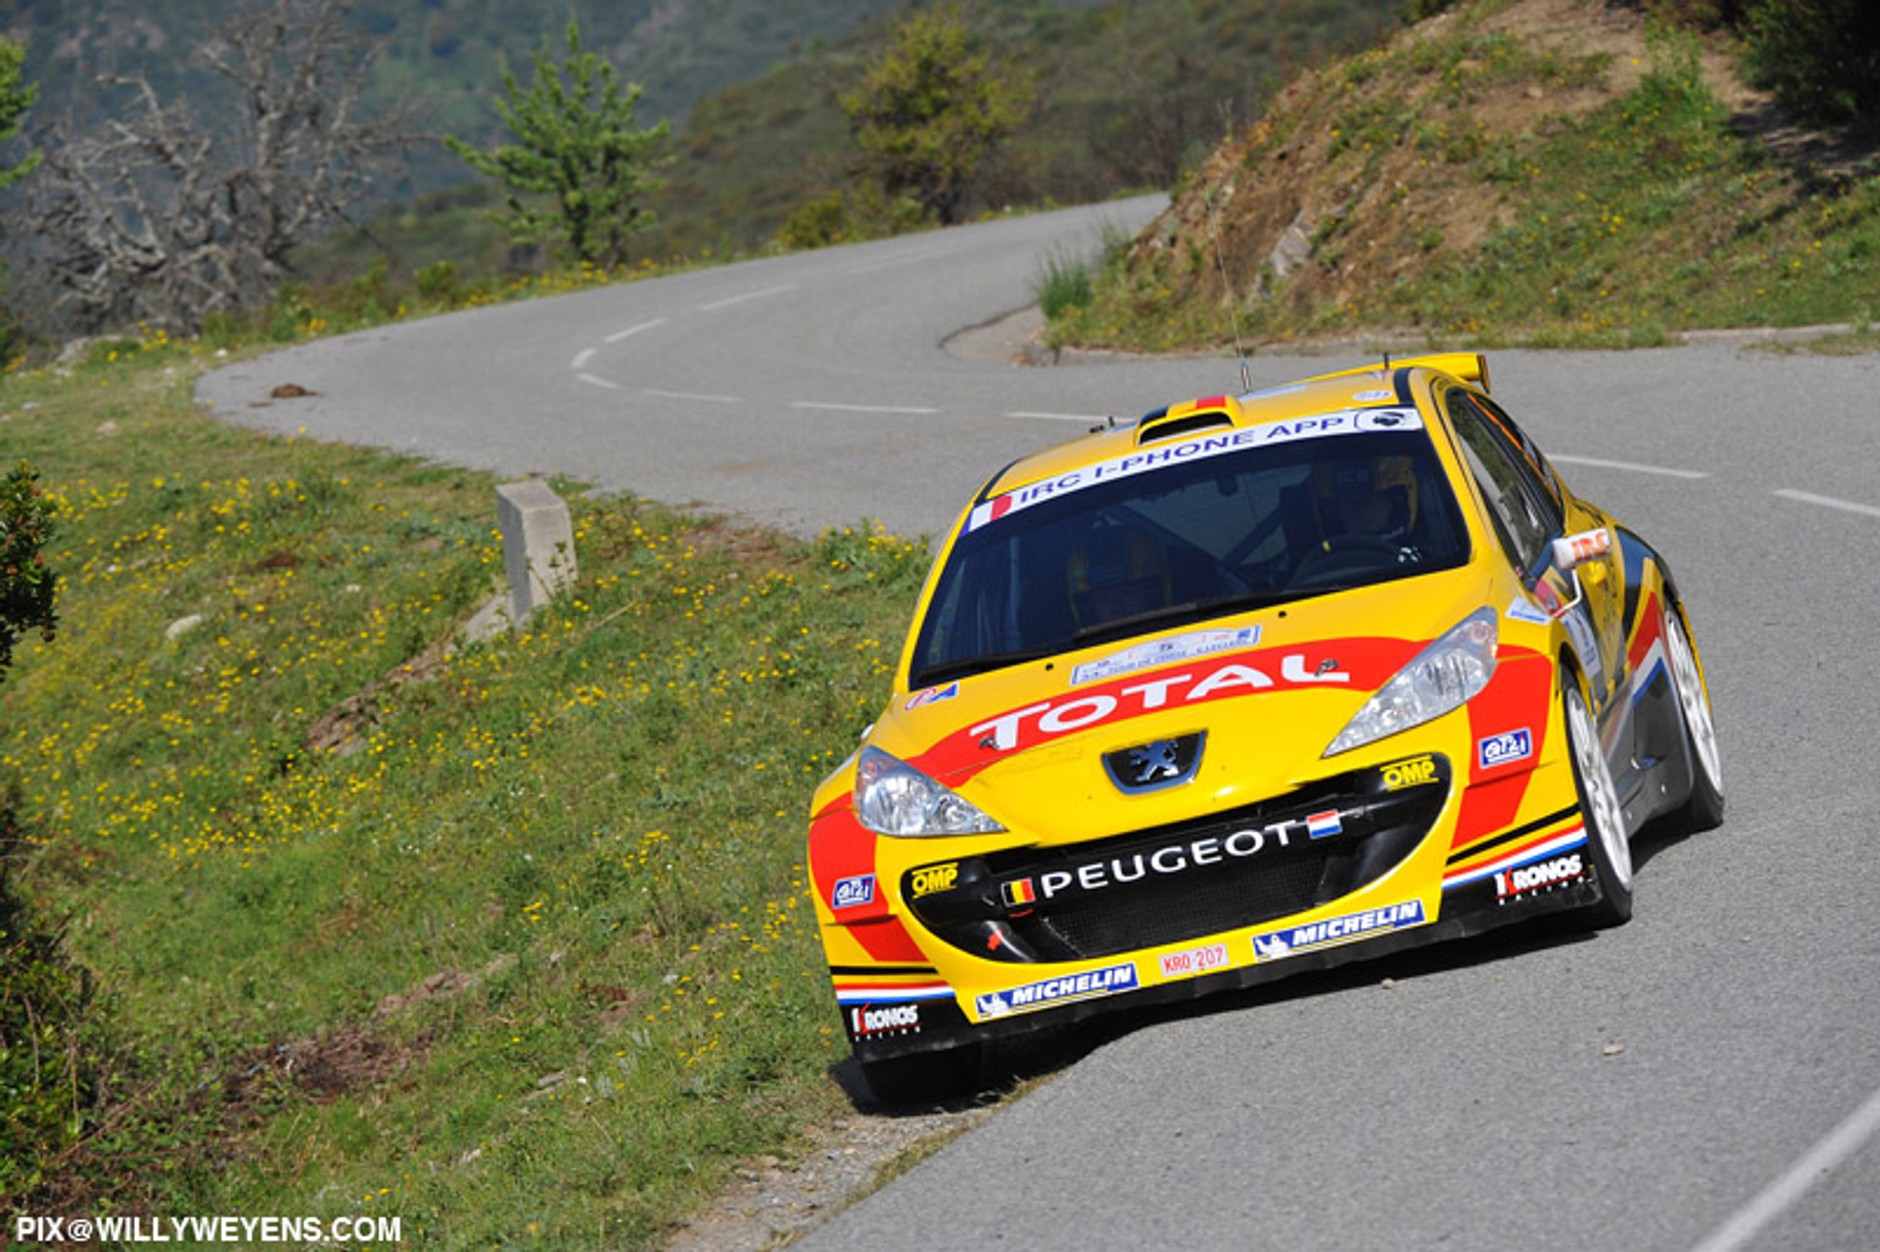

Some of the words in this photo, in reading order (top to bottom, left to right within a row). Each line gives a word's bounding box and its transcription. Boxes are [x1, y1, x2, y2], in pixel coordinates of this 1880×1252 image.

[1019, 472, 1082, 505] IRC
[1094, 430, 1256, 479] I-PHONE
[1266, 416, 1345, 440] APP
[970, 653, 1350, 751] TOTAL
[1383, 756, 1439, 790] OMP
[912, 864, 959, 897] OMP
[1041, 819, 1299, 900] PEUGEOT
[1494, 854, 1583, 896] KRONOS
[1291, 901, 1419, 947] MICHELIN
[1010, 965, 1133, 1006] MICHELIN
[851, 1001, 918, 1034] KRONOS
